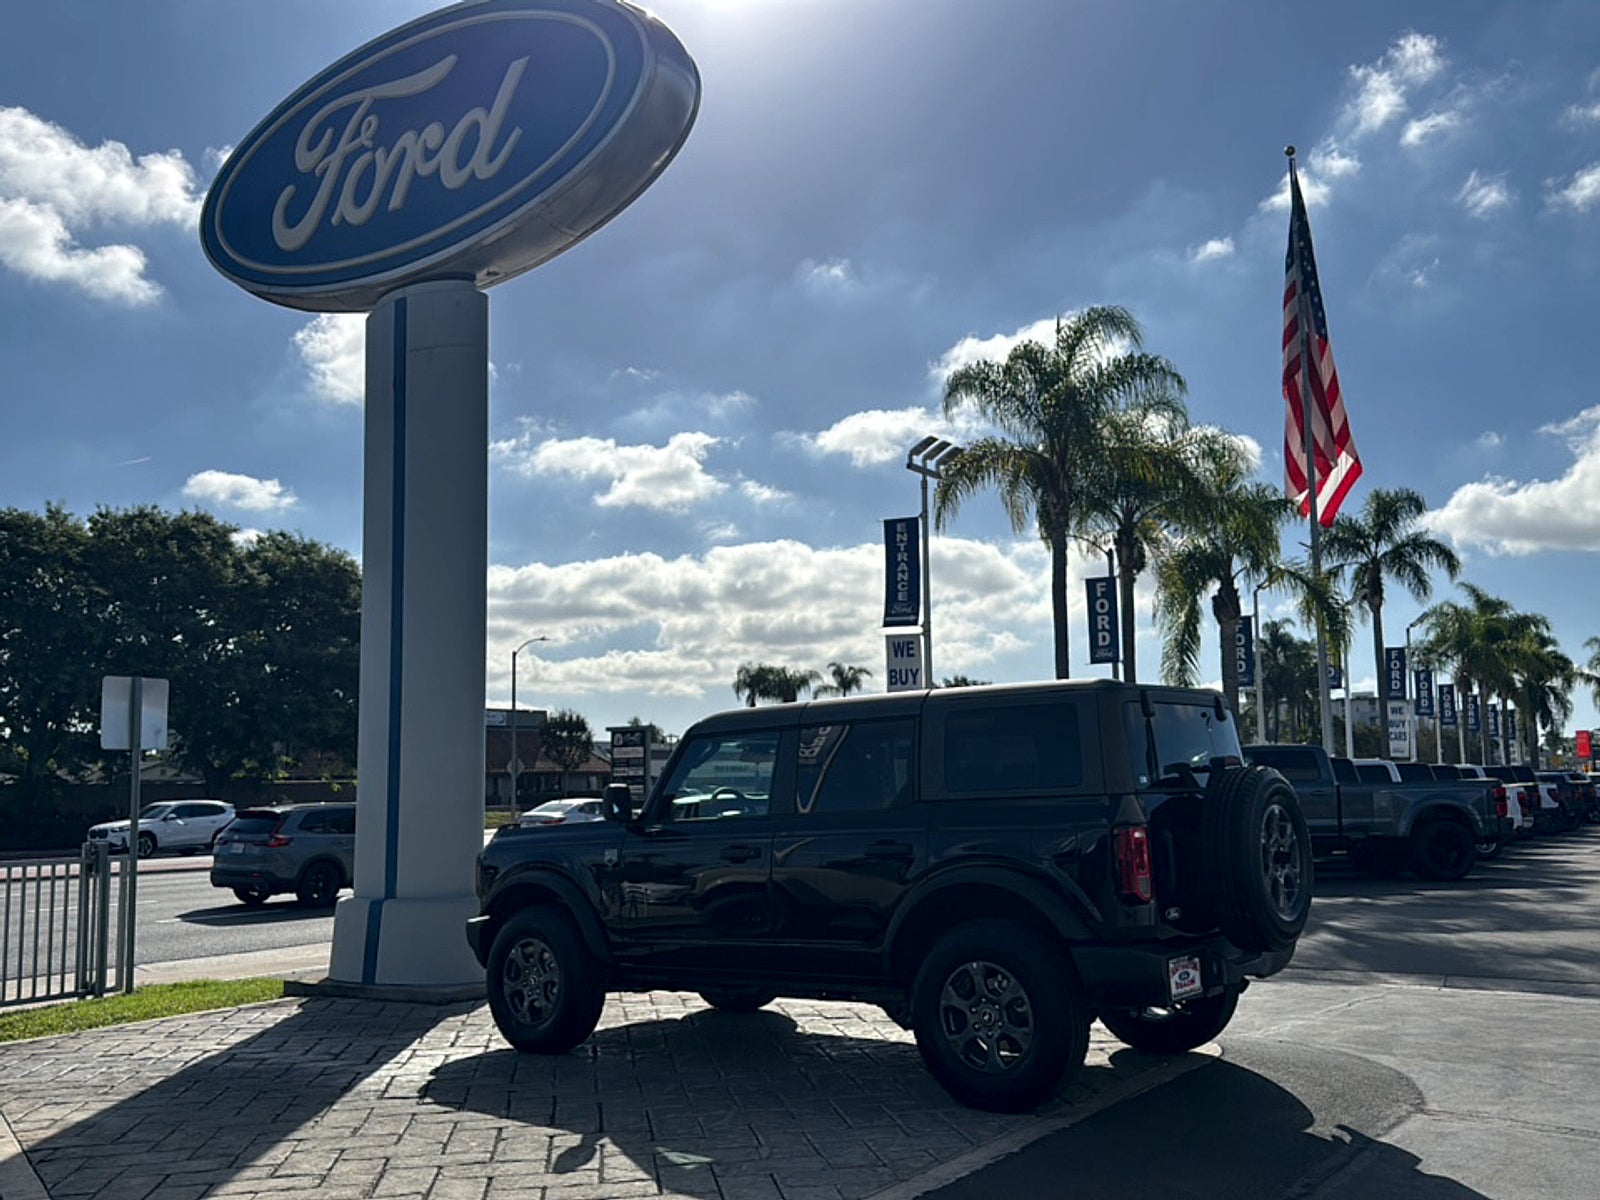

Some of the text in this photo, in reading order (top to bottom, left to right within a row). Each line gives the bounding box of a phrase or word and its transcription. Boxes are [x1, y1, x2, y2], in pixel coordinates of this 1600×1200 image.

[272, 53, 531, 252] Ford
[896, 522, 909, 601] ENTRANCE
[1095, 582, 1111, 647] FORD
[892, 640, 915, 658] WE
[1235, 620, 1246, 673] FORD
[889, 668, 919, 686] BUY
[1391, 650, 1401, 690] FORD
[1420, 670, 1429, 708] FORD
[1443, 687, 1452, 718] FORD
